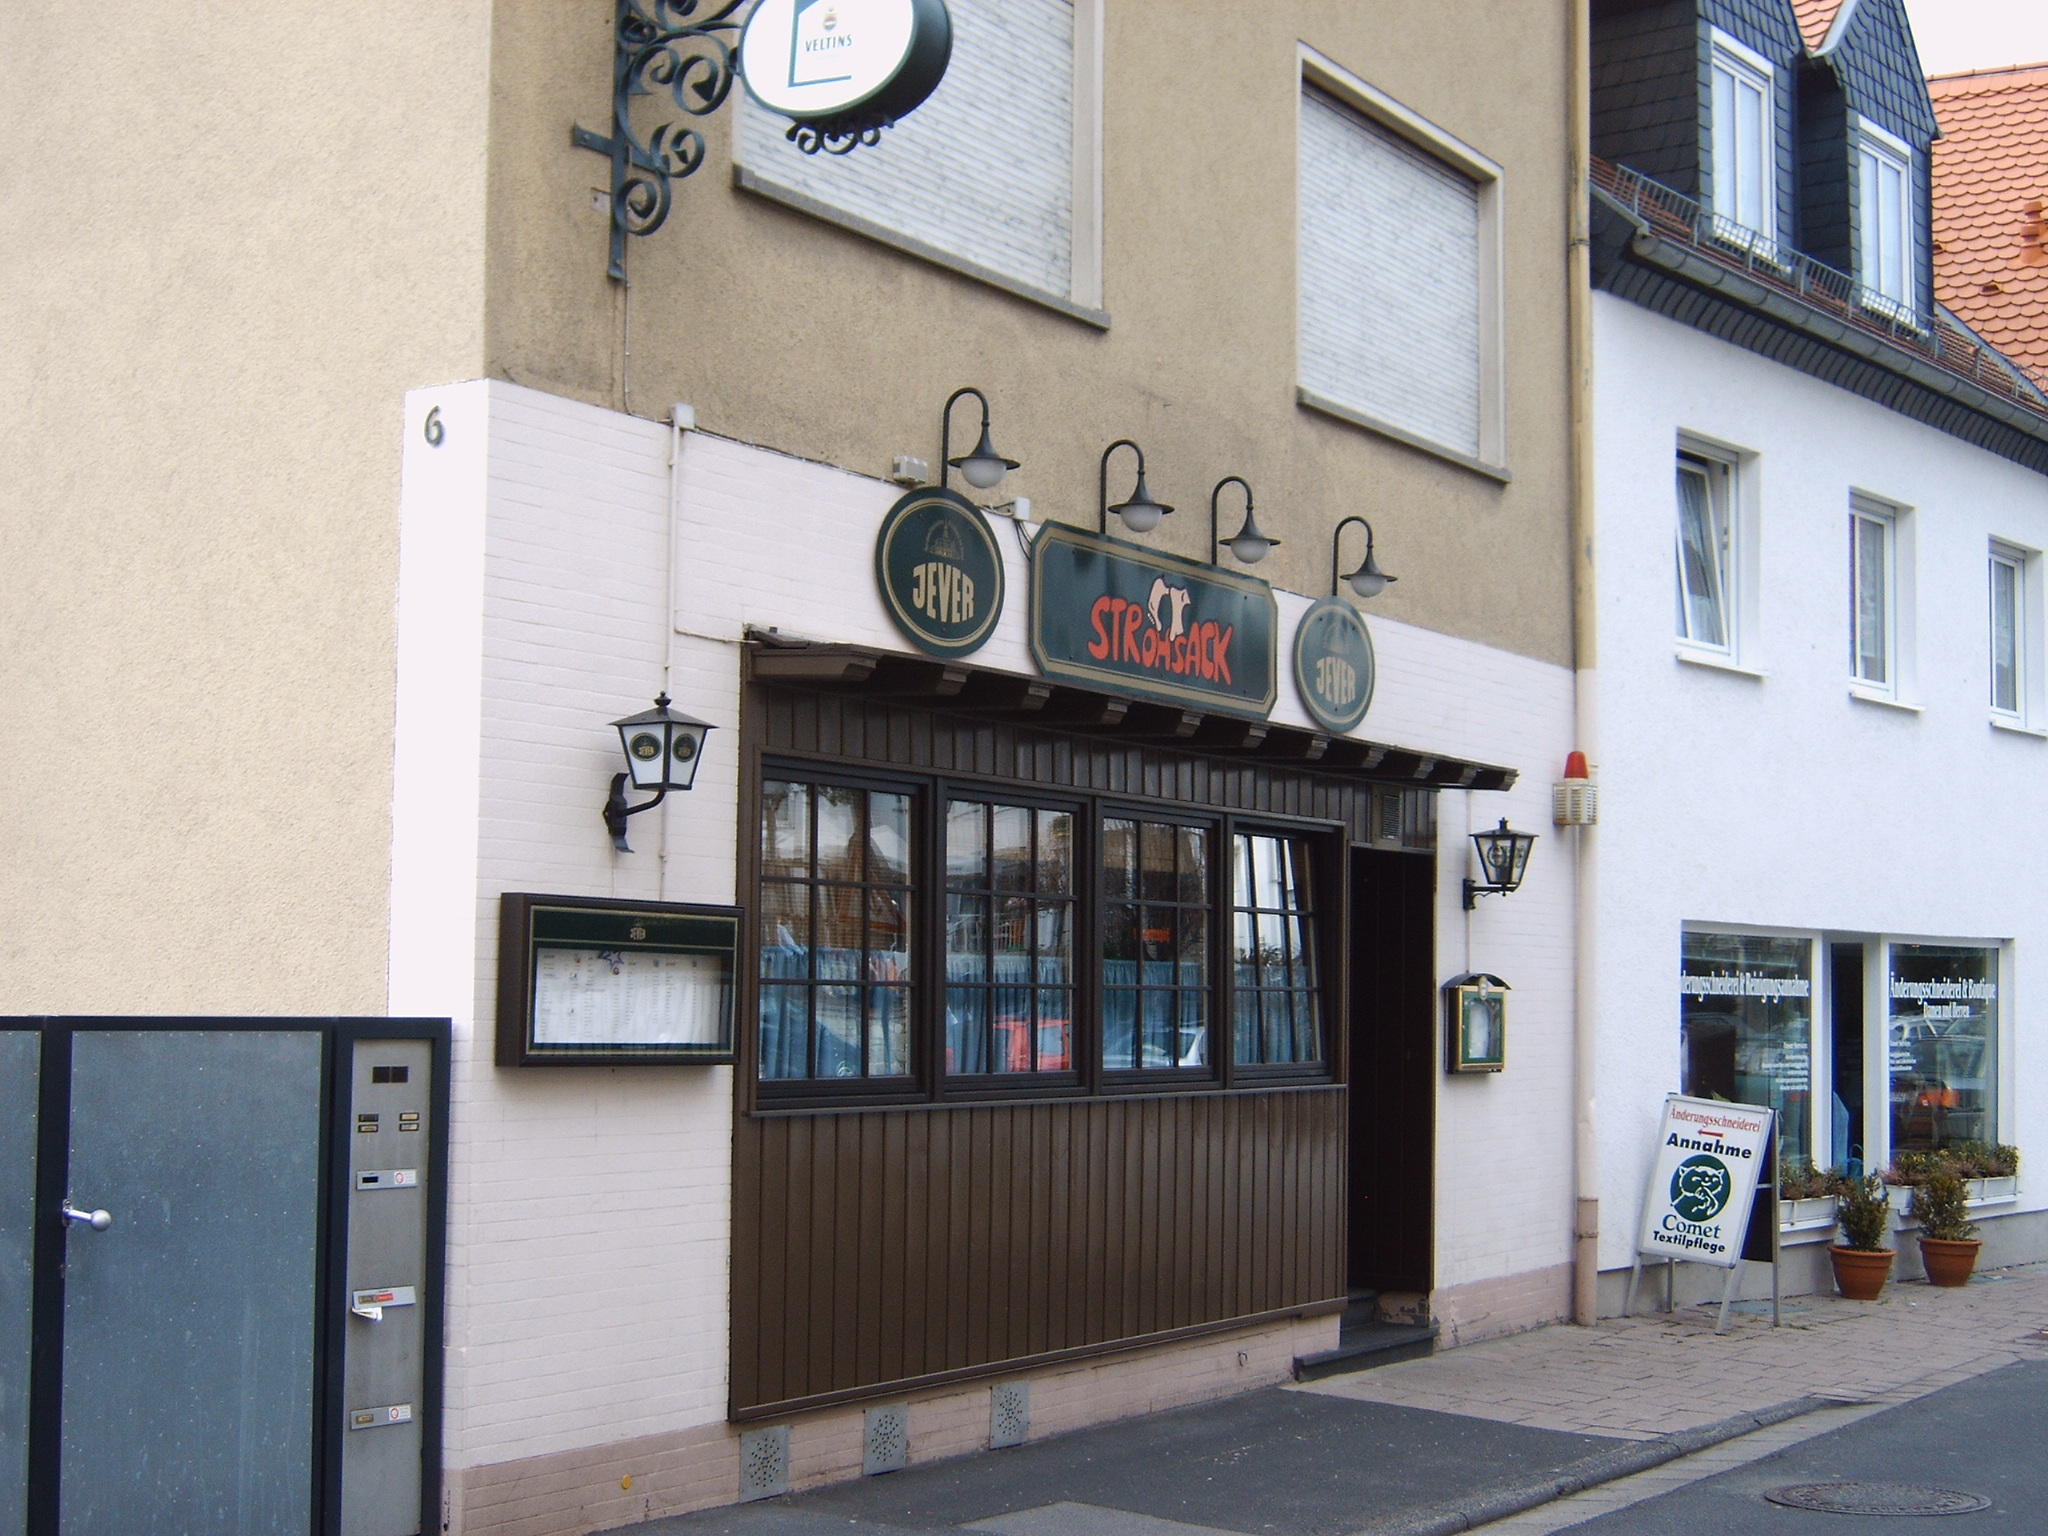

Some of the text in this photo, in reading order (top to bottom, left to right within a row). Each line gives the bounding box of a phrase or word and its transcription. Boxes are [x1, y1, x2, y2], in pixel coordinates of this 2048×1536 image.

[805, 34, 853, 53] VELTINS
[424, 404, 444, 448] 6
[912, 562, 975, 624] JEVER
[1087, 595, 1234, 687] STROHSACK
[1316, 656, 1356, 705] JEVER
[1962, 978, 1968, 998] &
[1968, 977, 1996, 1005] Boutique
[1666, 1132, 1753, 1159] Annahme
[1662, 1213, 1722, 1239] Comet
[1653, 1230, 1726, 1254] Textilpflege
